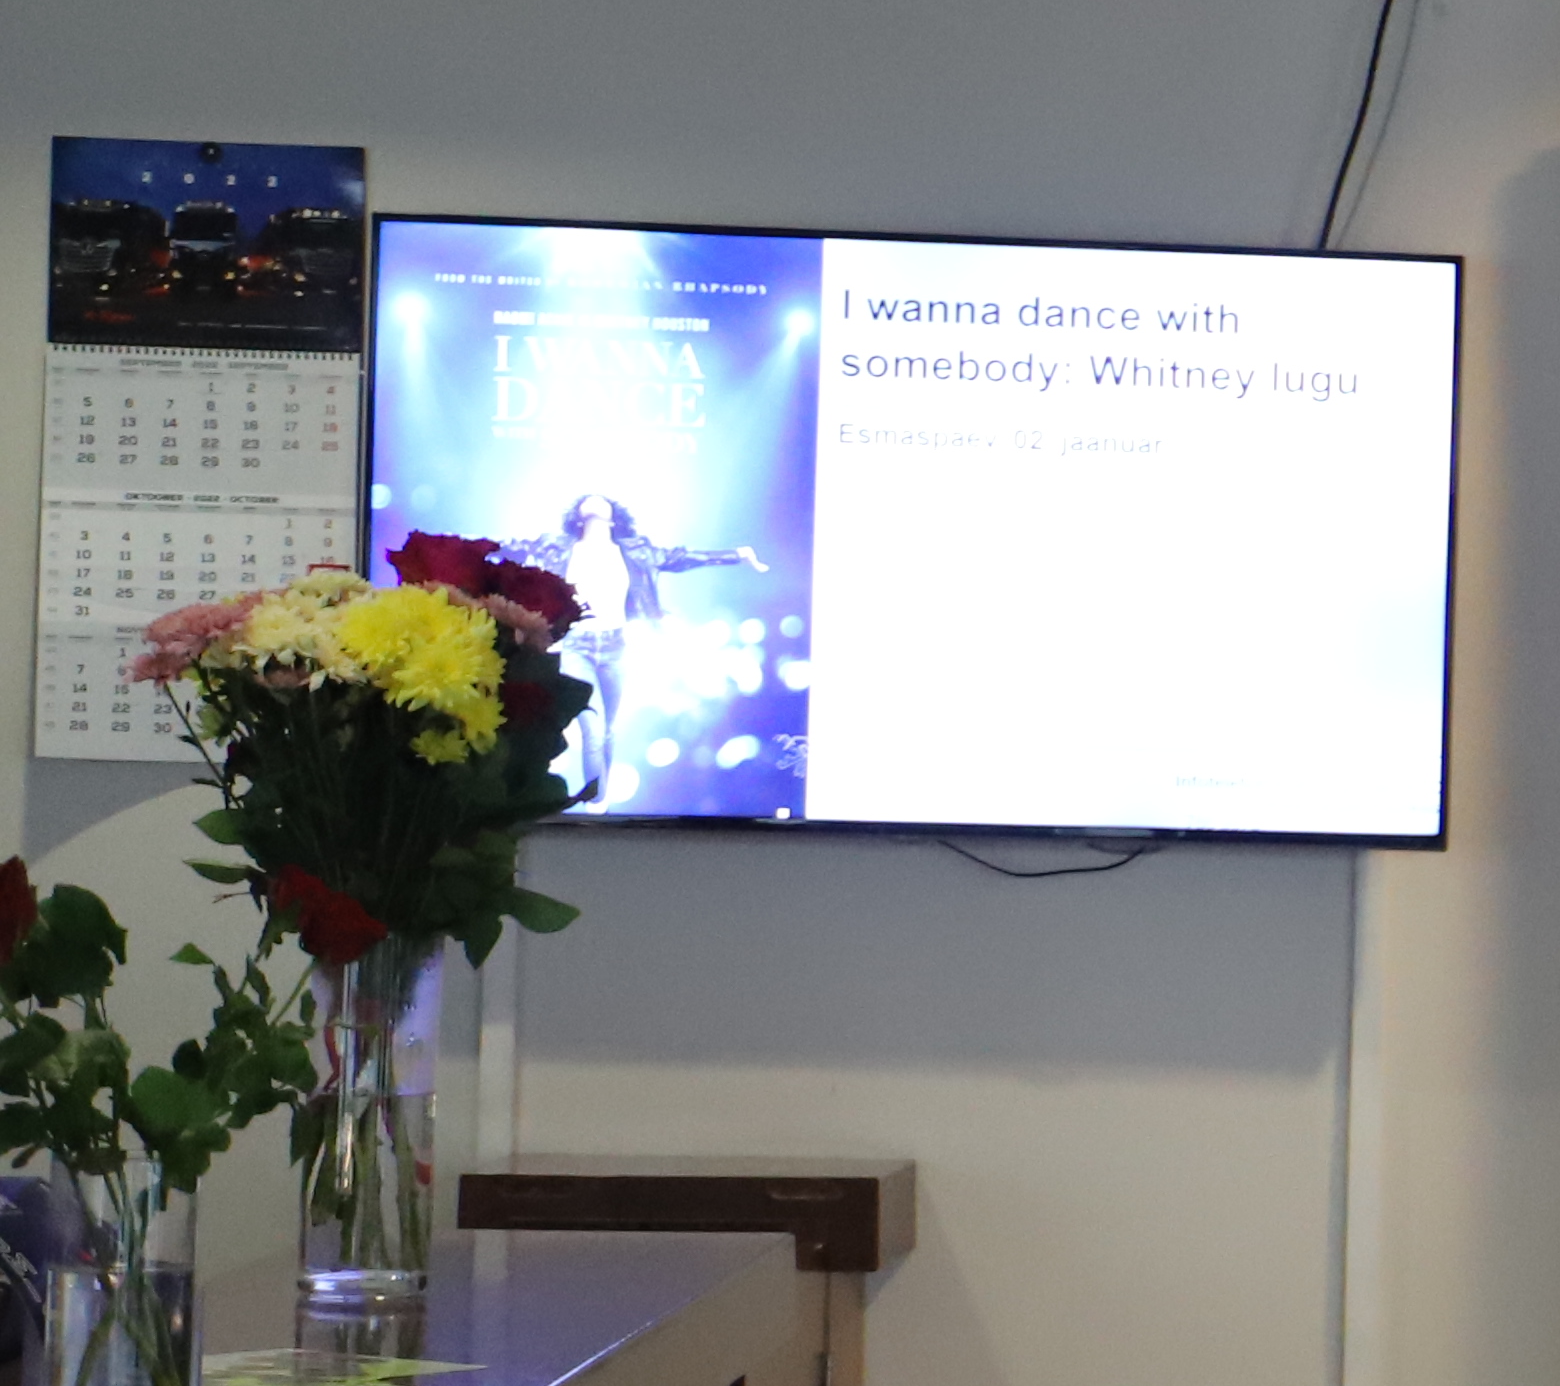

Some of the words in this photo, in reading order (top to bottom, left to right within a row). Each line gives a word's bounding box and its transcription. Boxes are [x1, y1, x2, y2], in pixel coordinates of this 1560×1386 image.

[844, 289, 850, 319] I
[867, 298, 1001, 325] wanna
[1018, 297, 1141, 330] dance
[1157, 303, 1238, 334] with
[492, 334, 514, 373] I
[524, 336, 707, 380] WANNA
[841, 351, 1071, 392] somebody:
[1090, 355, 1255, 399] Whitney
[1274, 362, 1357, 402] lugu
